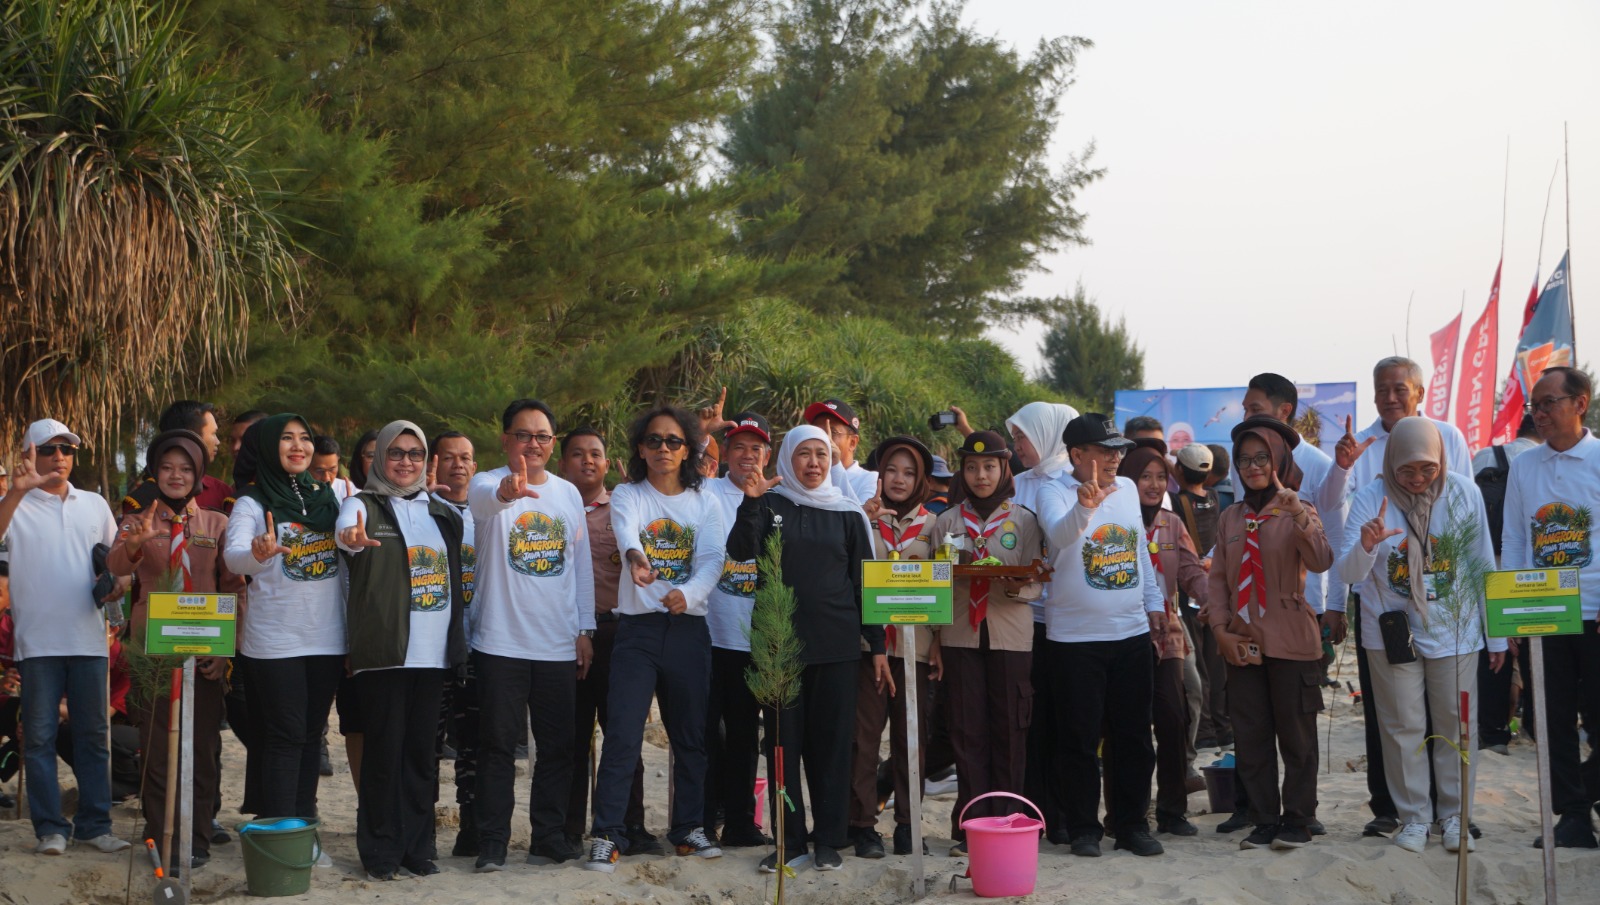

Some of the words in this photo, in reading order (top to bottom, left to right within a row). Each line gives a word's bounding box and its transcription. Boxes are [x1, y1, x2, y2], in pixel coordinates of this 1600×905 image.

[1535, 530, 1585, 546] MANGROVE
[515, 539, 563, 553] MANGROVE
[1559, 542, 1580, 550] TIMUR
[299, 555, 316, 567] JAWA
[317, 551, 335, 560] TIMUR
[523, 551, 540, 561] JAWA
[541, 550, 559, 558] TIMUR
[645, 546, 690, 560] MANGROVE
[536, 559, 548, 571] 10
[1090, 551, 1136, 569] MANGROVE
[312, 561, 324, 576] 10
[411, 566, 434, 576] Festival
[1101, 565, 1119, 576] JAWA
[1116, 571, 1127, 584] 10
[412, 587, 425, 596] AWA
[427, 585, 443, 593] TIMUR
[421, 593, 433, 606] 10
